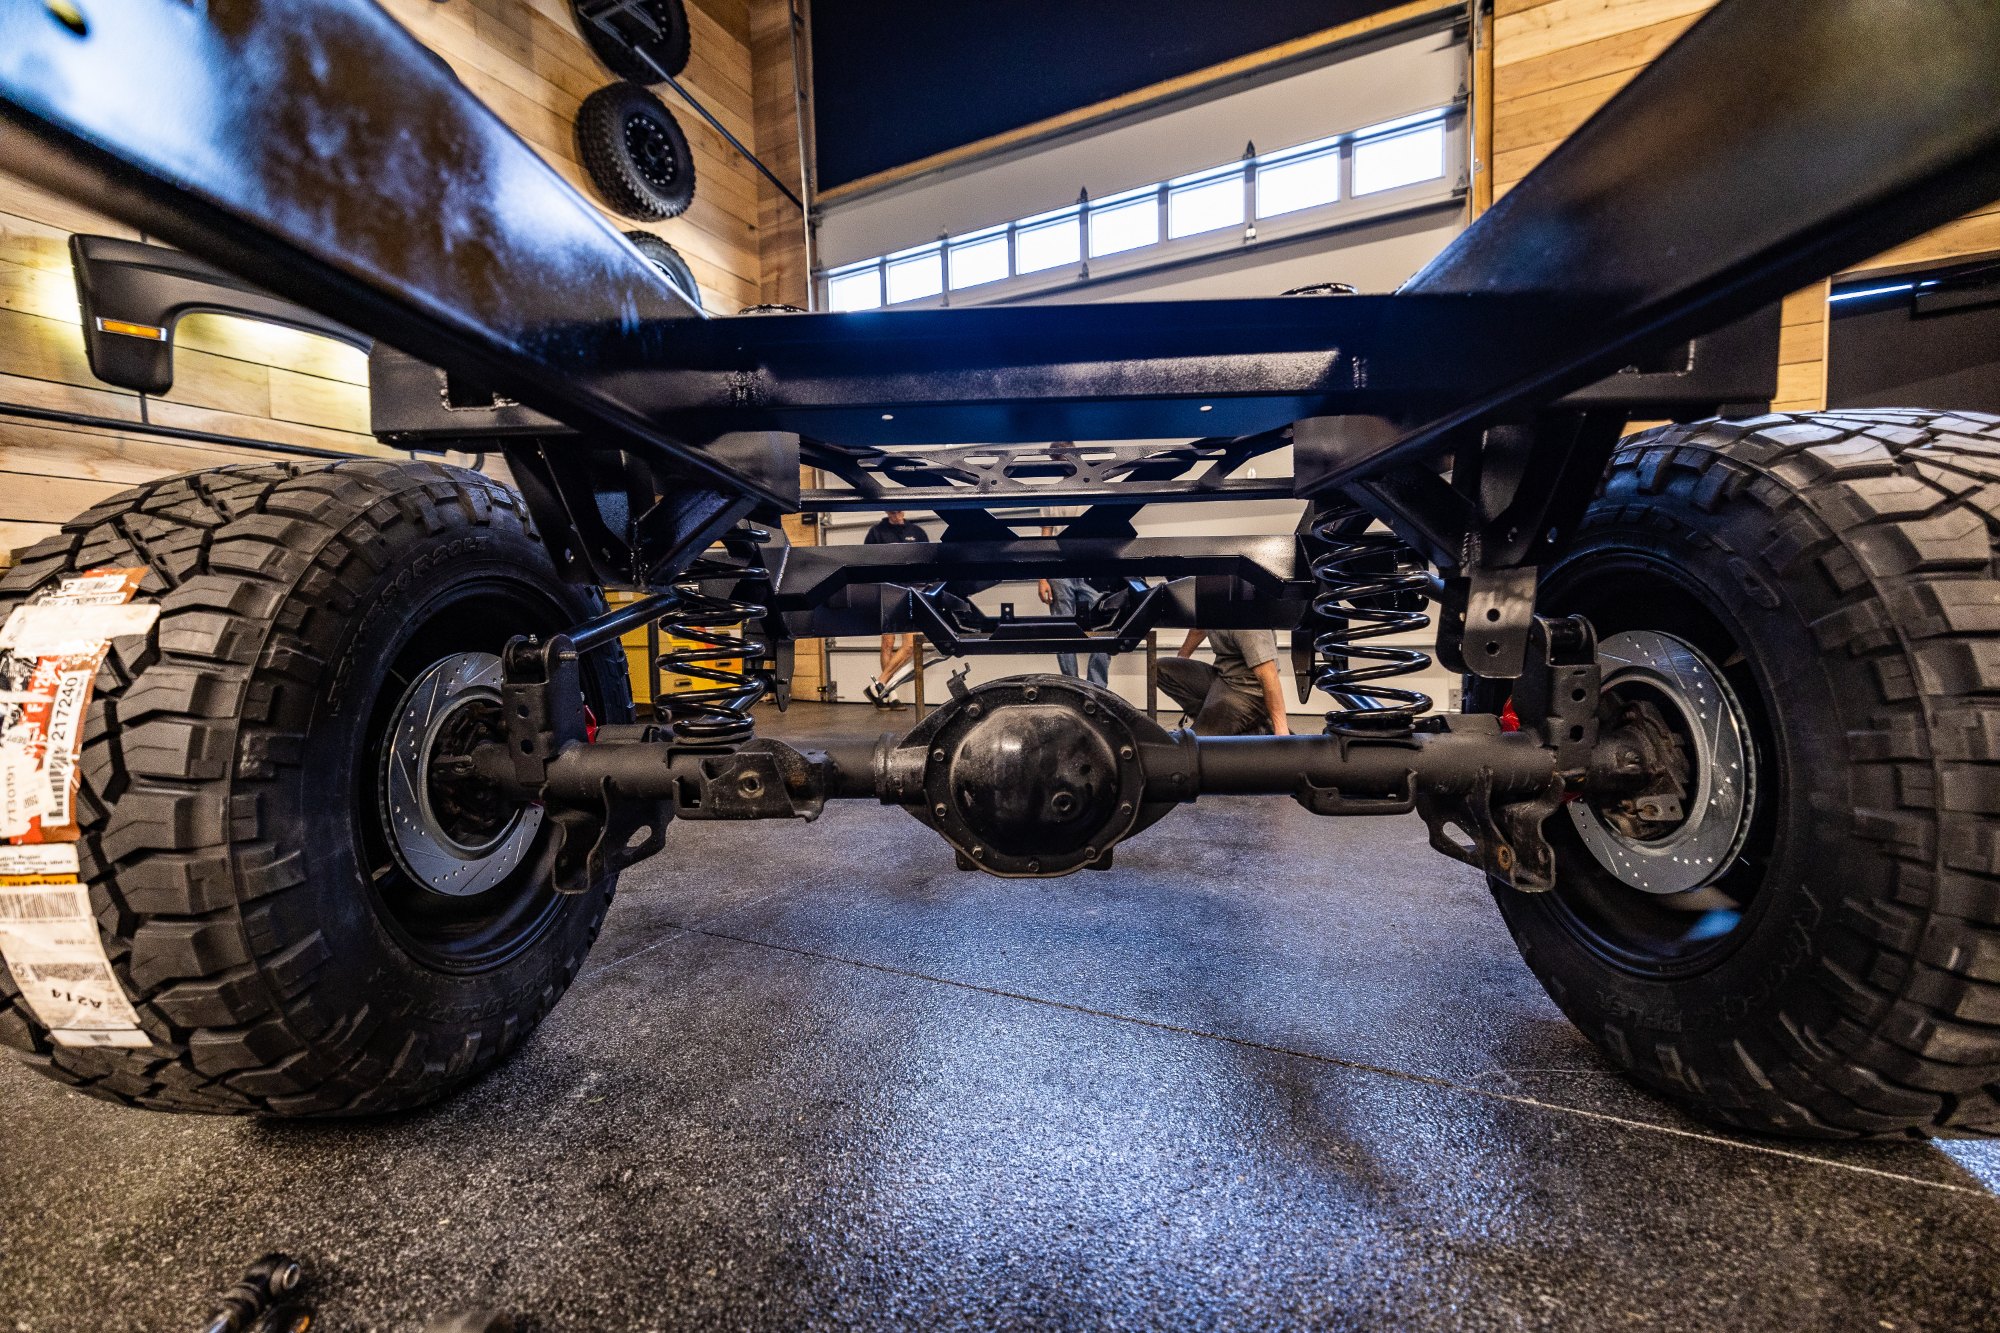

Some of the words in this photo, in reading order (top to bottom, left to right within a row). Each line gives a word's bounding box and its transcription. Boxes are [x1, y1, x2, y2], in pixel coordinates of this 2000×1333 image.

[52, 677, 78, 740] 217240
[7, 765, 17, 824] 7130191
[52, 989, 102, 1008] A214
